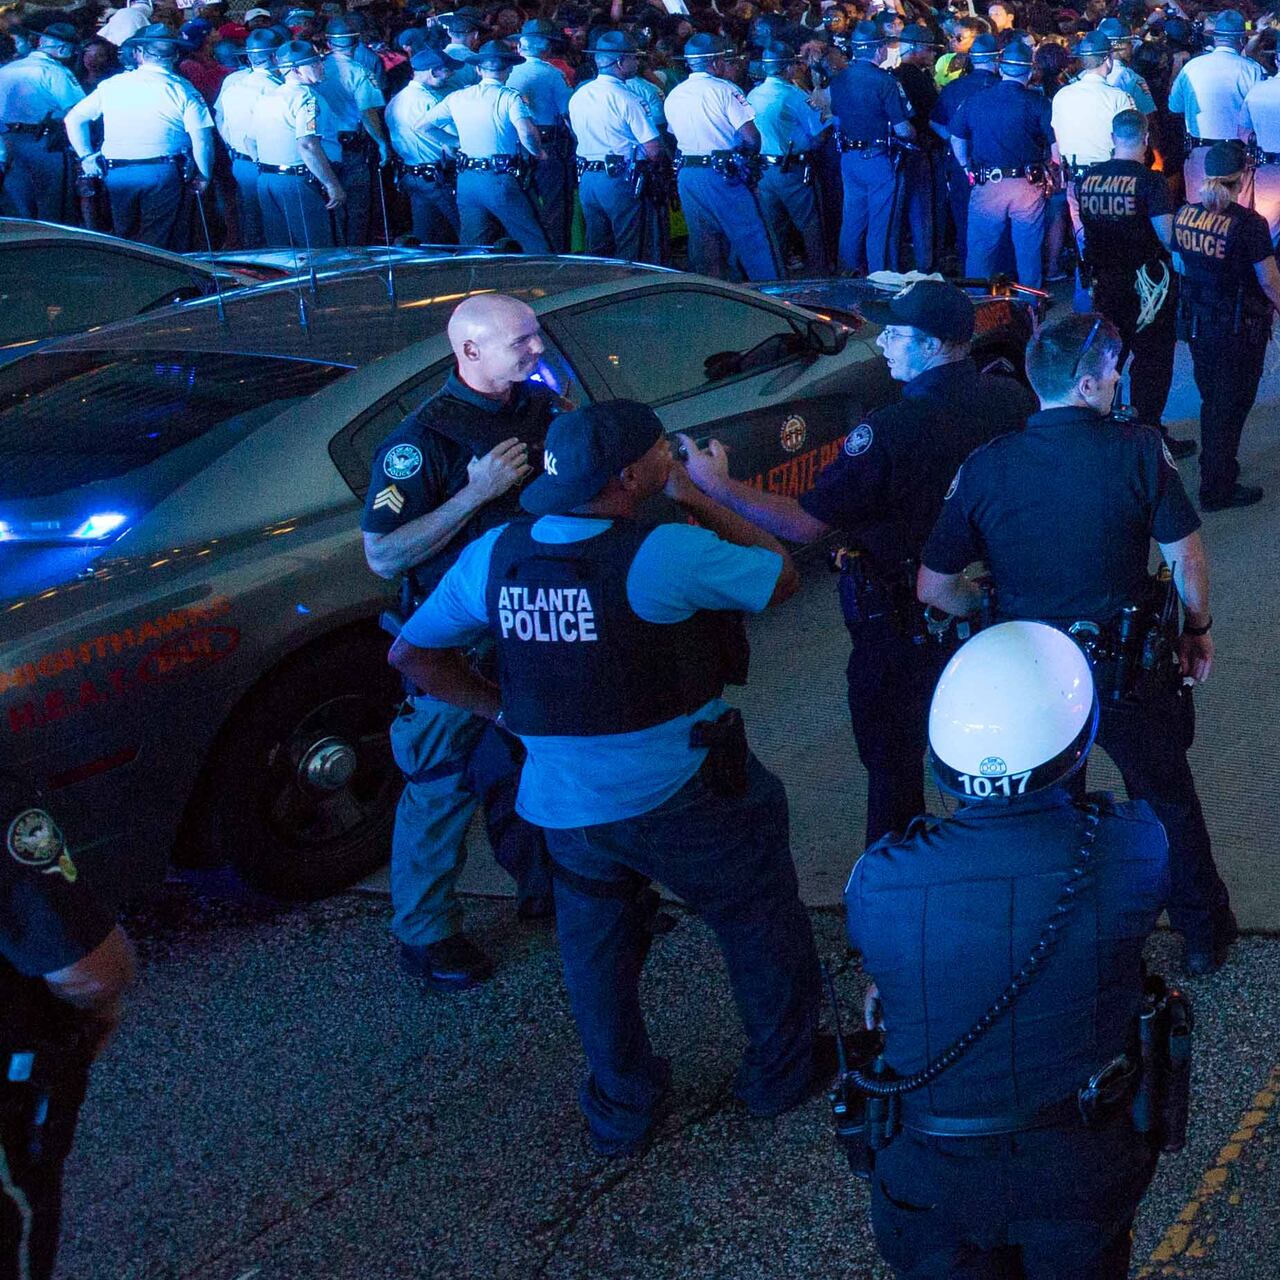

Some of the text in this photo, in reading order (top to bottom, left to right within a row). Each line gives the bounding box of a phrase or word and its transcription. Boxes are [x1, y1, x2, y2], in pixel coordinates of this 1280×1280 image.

[1080, 175, 1137, 195] ATLANTA
[1080, 195, 1137, 216] POLICE
[1176, 206, 1233, 237] ATLANTA
[1175, 228, 1227, 260] POLICE
[498, 586, 593, 612] ATLANTA
[498, 609, 598, 642] POLICE
[957, 770, 1033, 797] 1017
